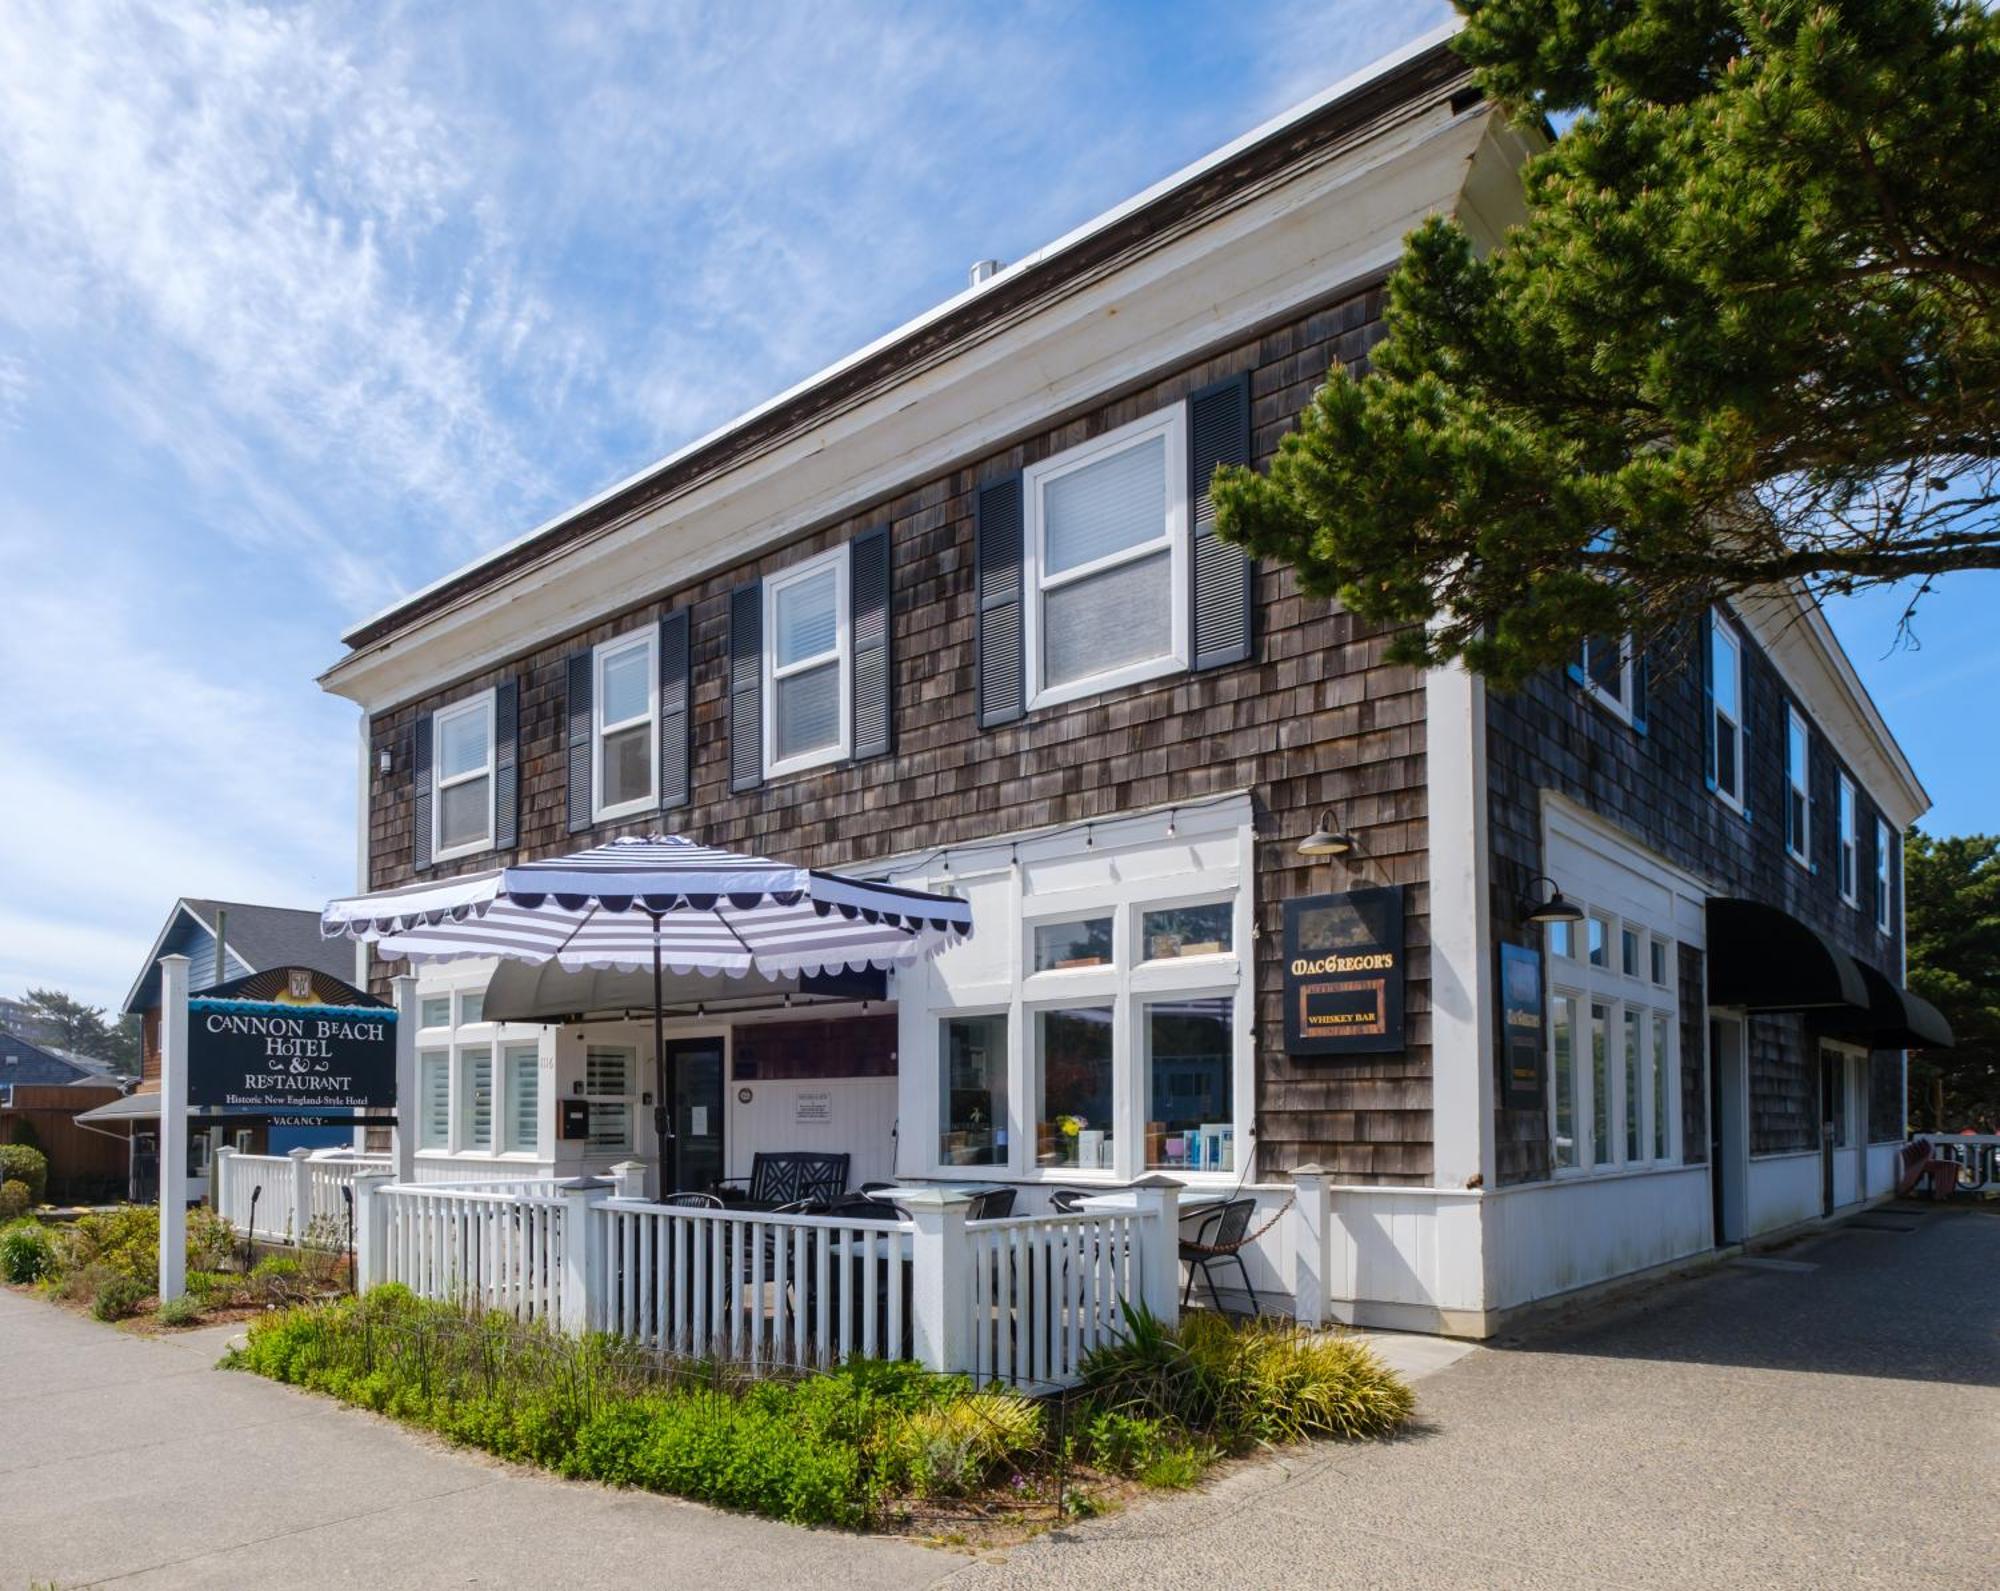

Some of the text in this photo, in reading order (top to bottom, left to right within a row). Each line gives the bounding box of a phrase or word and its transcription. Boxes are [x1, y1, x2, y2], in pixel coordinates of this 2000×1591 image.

[1308, 1012, 1375, 1024] WHISKEY BAR
[206, 1014, 384, 1041] CANNON BEACH
[265, 1037, 333, 1058] HOTEL
[289, 1057, 310, 1074] &
[245, 1074, 352, 1091] RESTAURANT
[226, 1094, 262, 1104] Historic
[265, 1095, 284, 1104] New
[346, 1096, 368, 1105] Hotel
